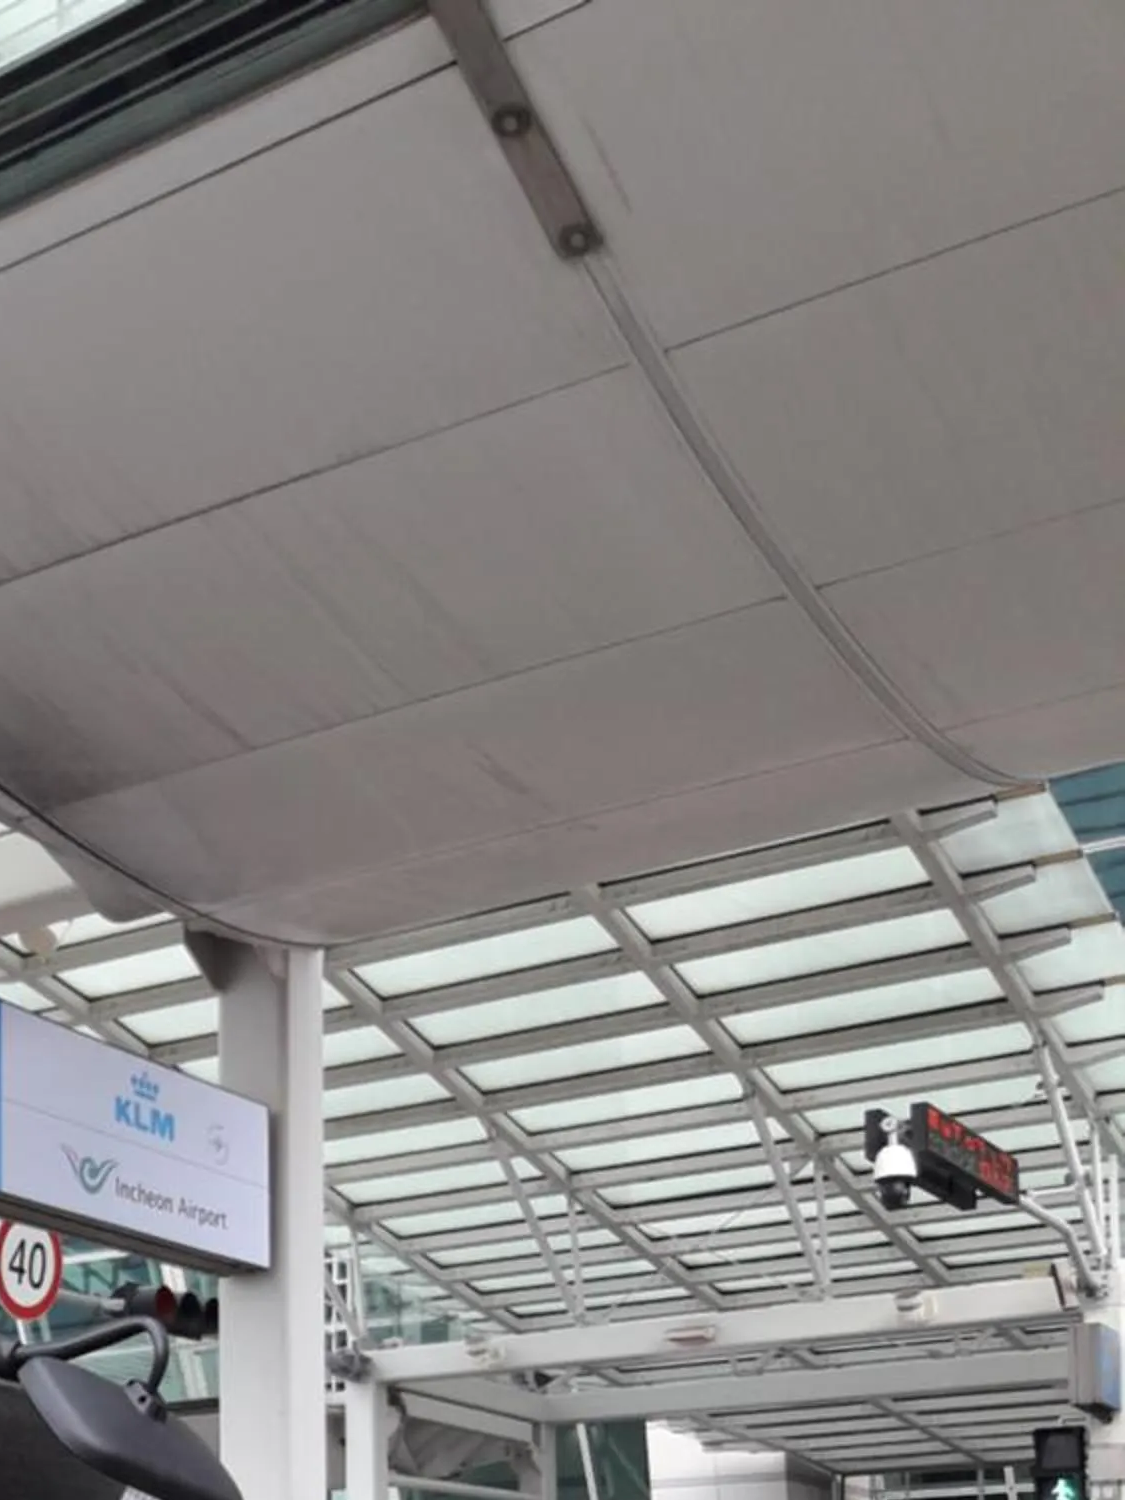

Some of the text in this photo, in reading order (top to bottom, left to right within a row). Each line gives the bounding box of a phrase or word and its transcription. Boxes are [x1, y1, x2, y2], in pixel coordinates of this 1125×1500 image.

[115, 1096, 175, 1142] KLM
[114, 1176, 229, 1230] Incheon Airport
[8, 1238, 46, 1290] 40
